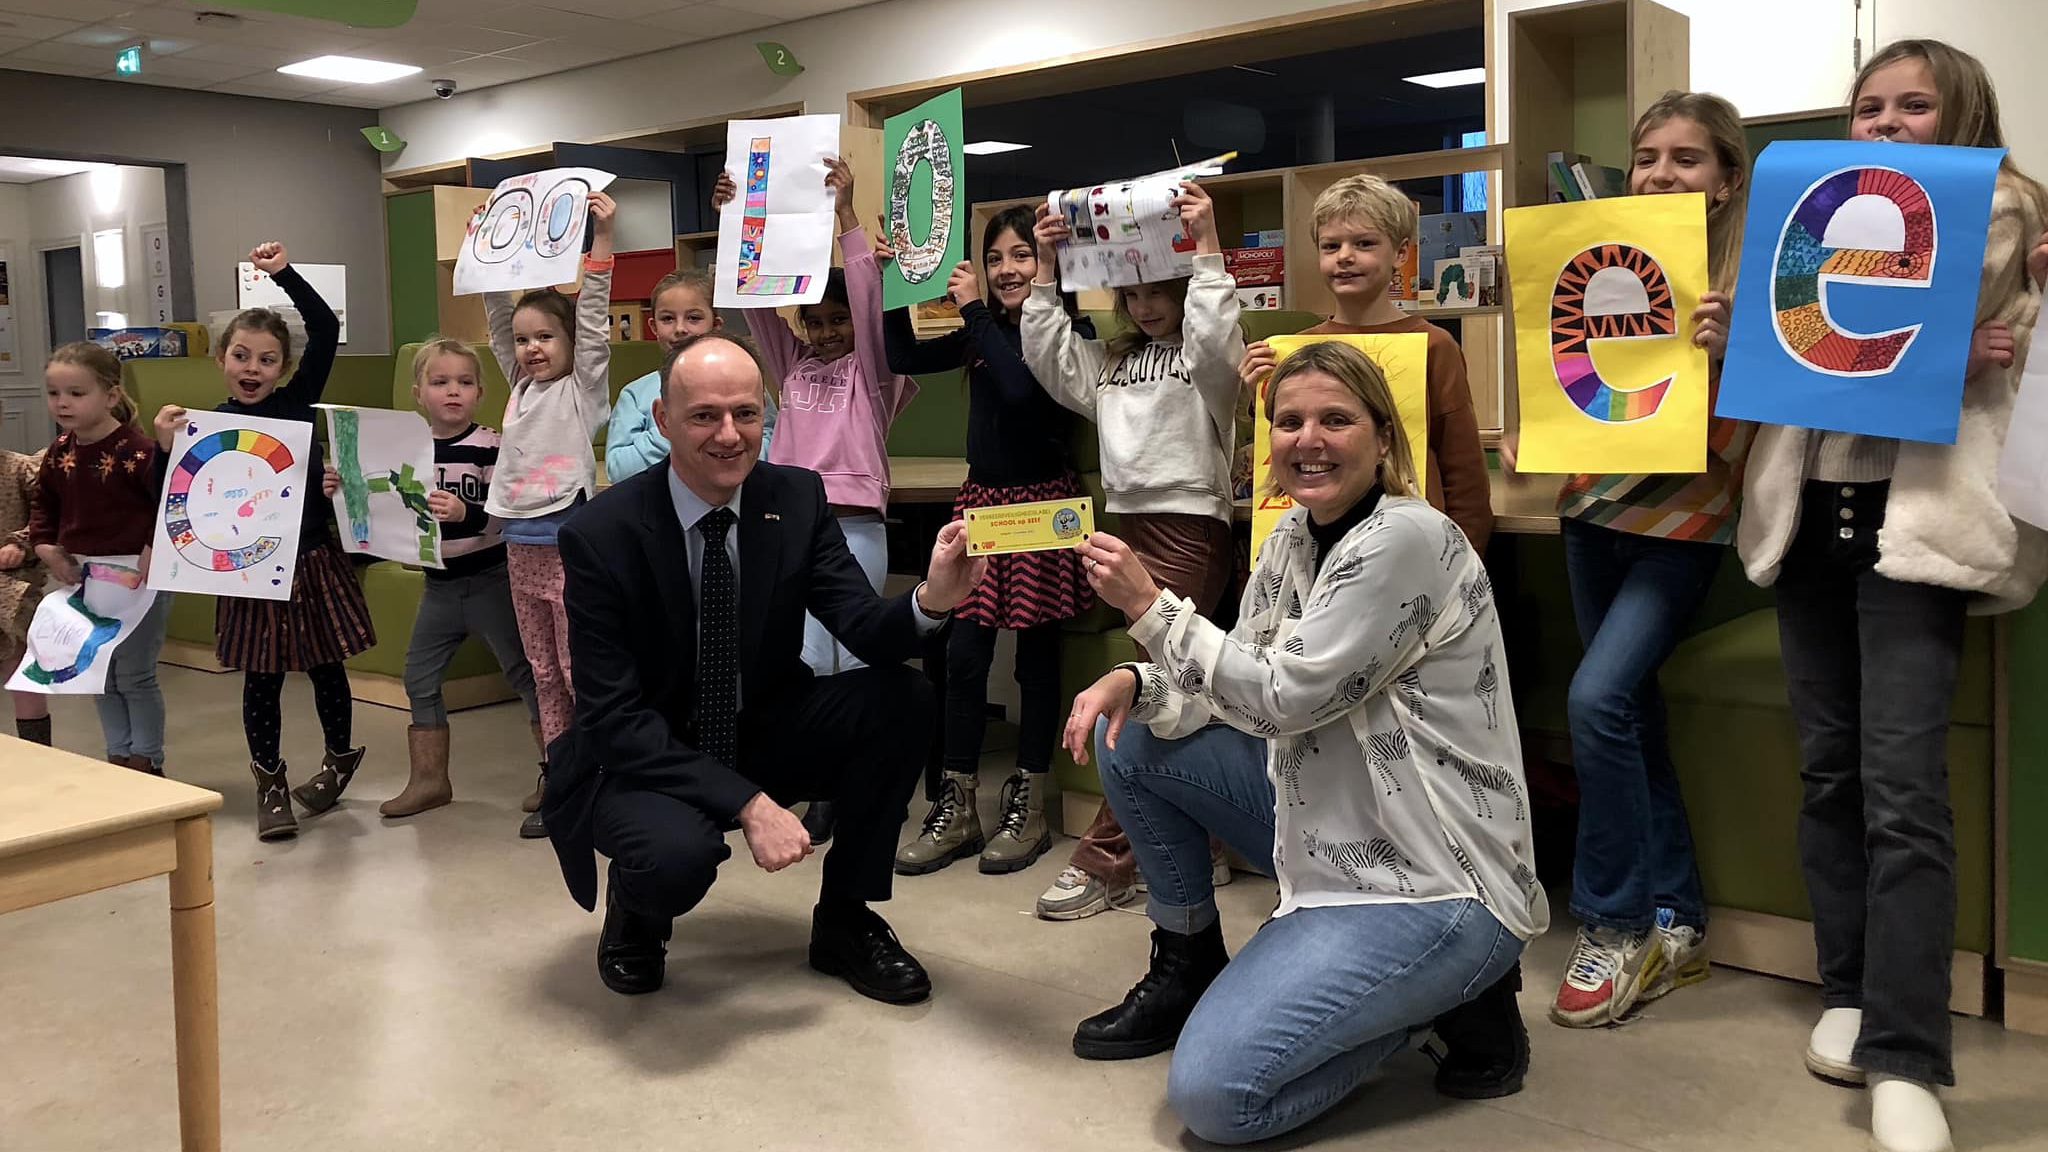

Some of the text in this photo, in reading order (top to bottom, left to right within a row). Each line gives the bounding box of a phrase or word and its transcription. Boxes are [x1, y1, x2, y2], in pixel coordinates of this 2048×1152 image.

[776, 49, 785, 65] 2
[380, 131, 390, 144] 1
[1238, 250, 1275, 260] MONOPOLY
[1769, 165, 1938, 378] e
[1551, 242, 1678, 424] e
[792, 372, 848, 386] ANGELE
[990, 519, 1016, 527] SCHOOL
